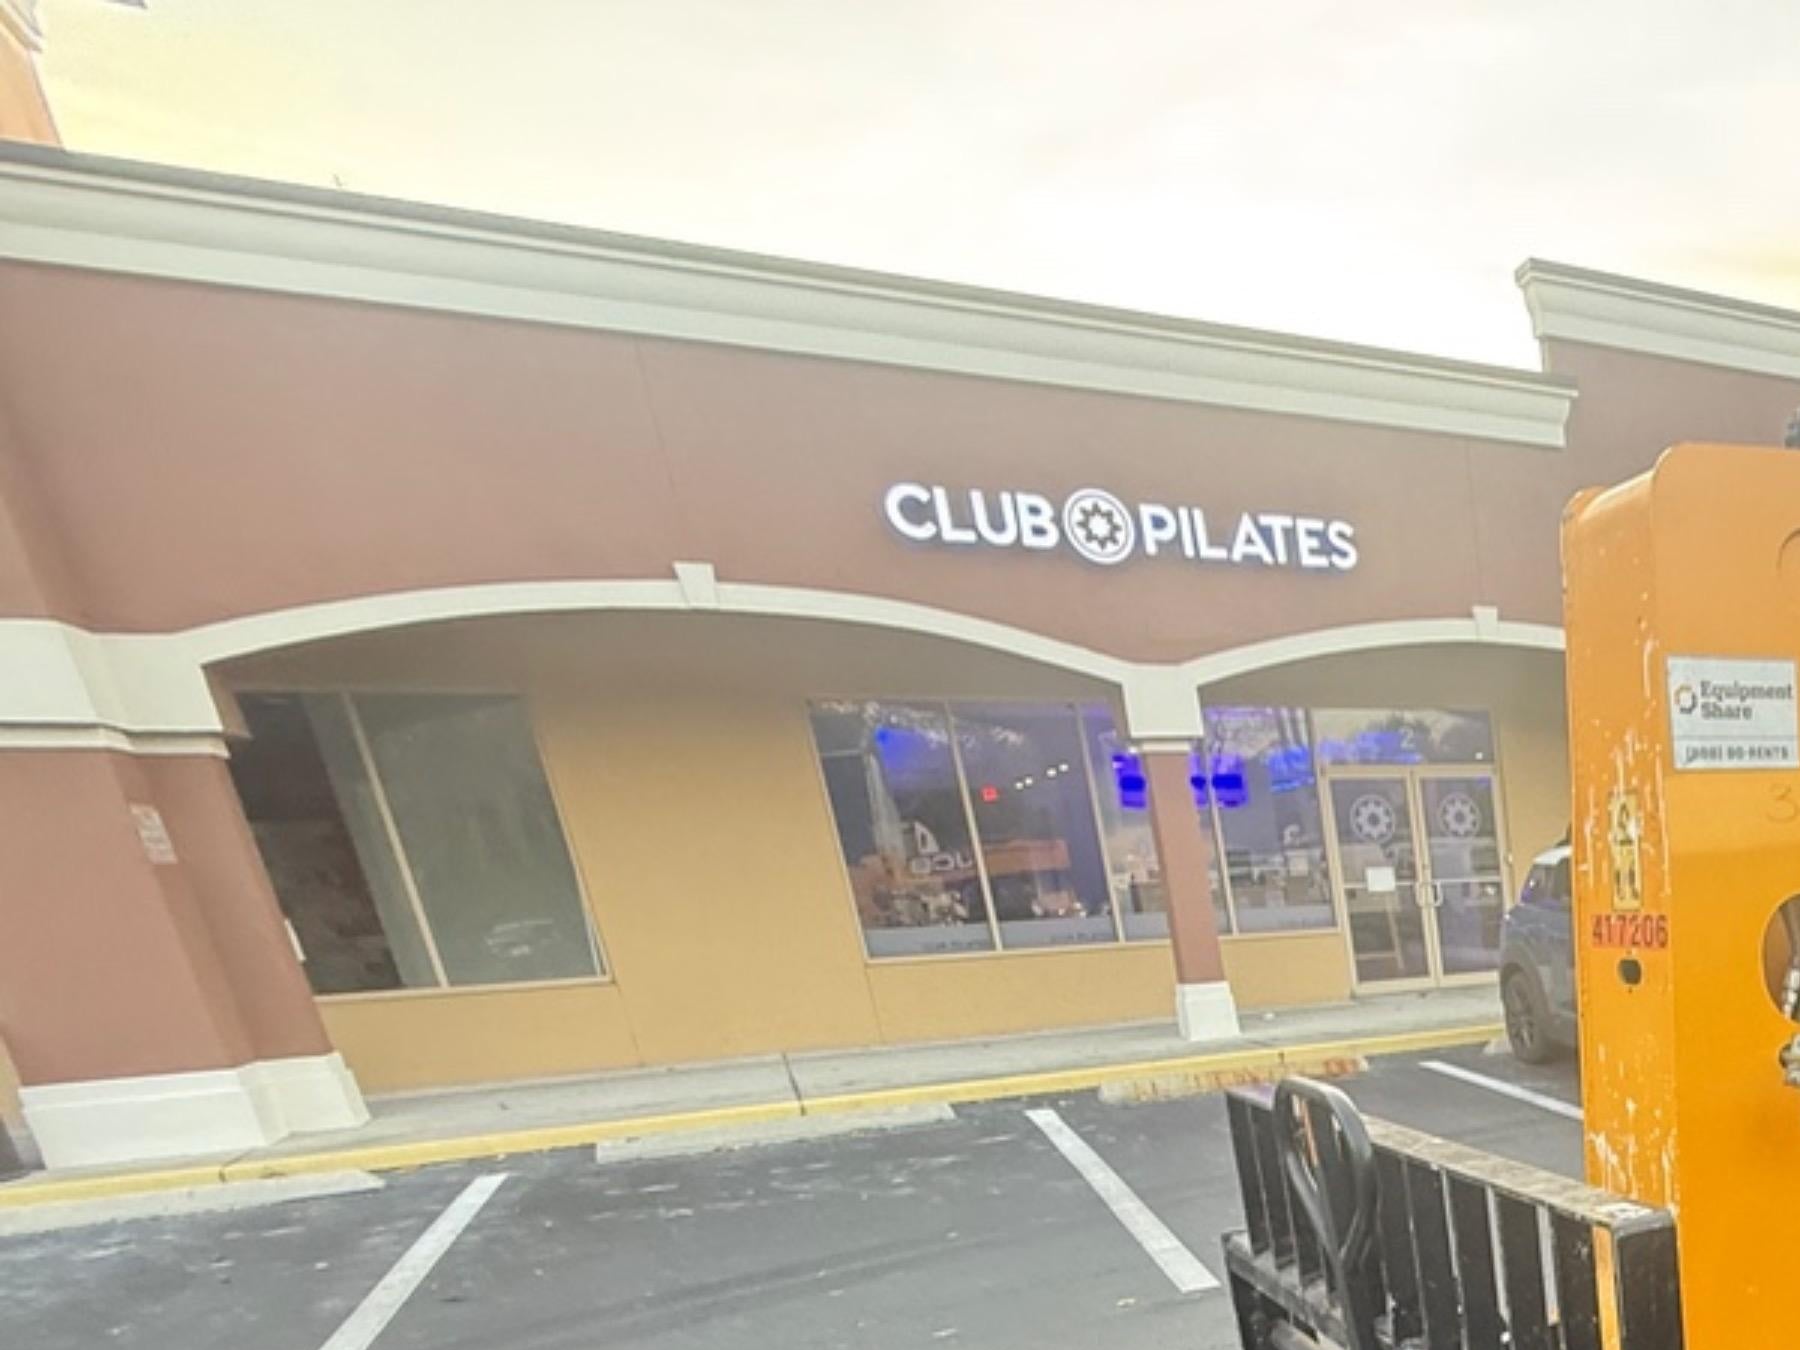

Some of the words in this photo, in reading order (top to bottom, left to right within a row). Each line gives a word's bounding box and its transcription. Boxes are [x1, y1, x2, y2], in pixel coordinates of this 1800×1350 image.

[884, 482, 1060, 549] CLUB
[1139, 503, 1359, 569] PILATES
[1700, 680, 1792, 702] Equipment
[1700, 701, 1753, 720] Share
